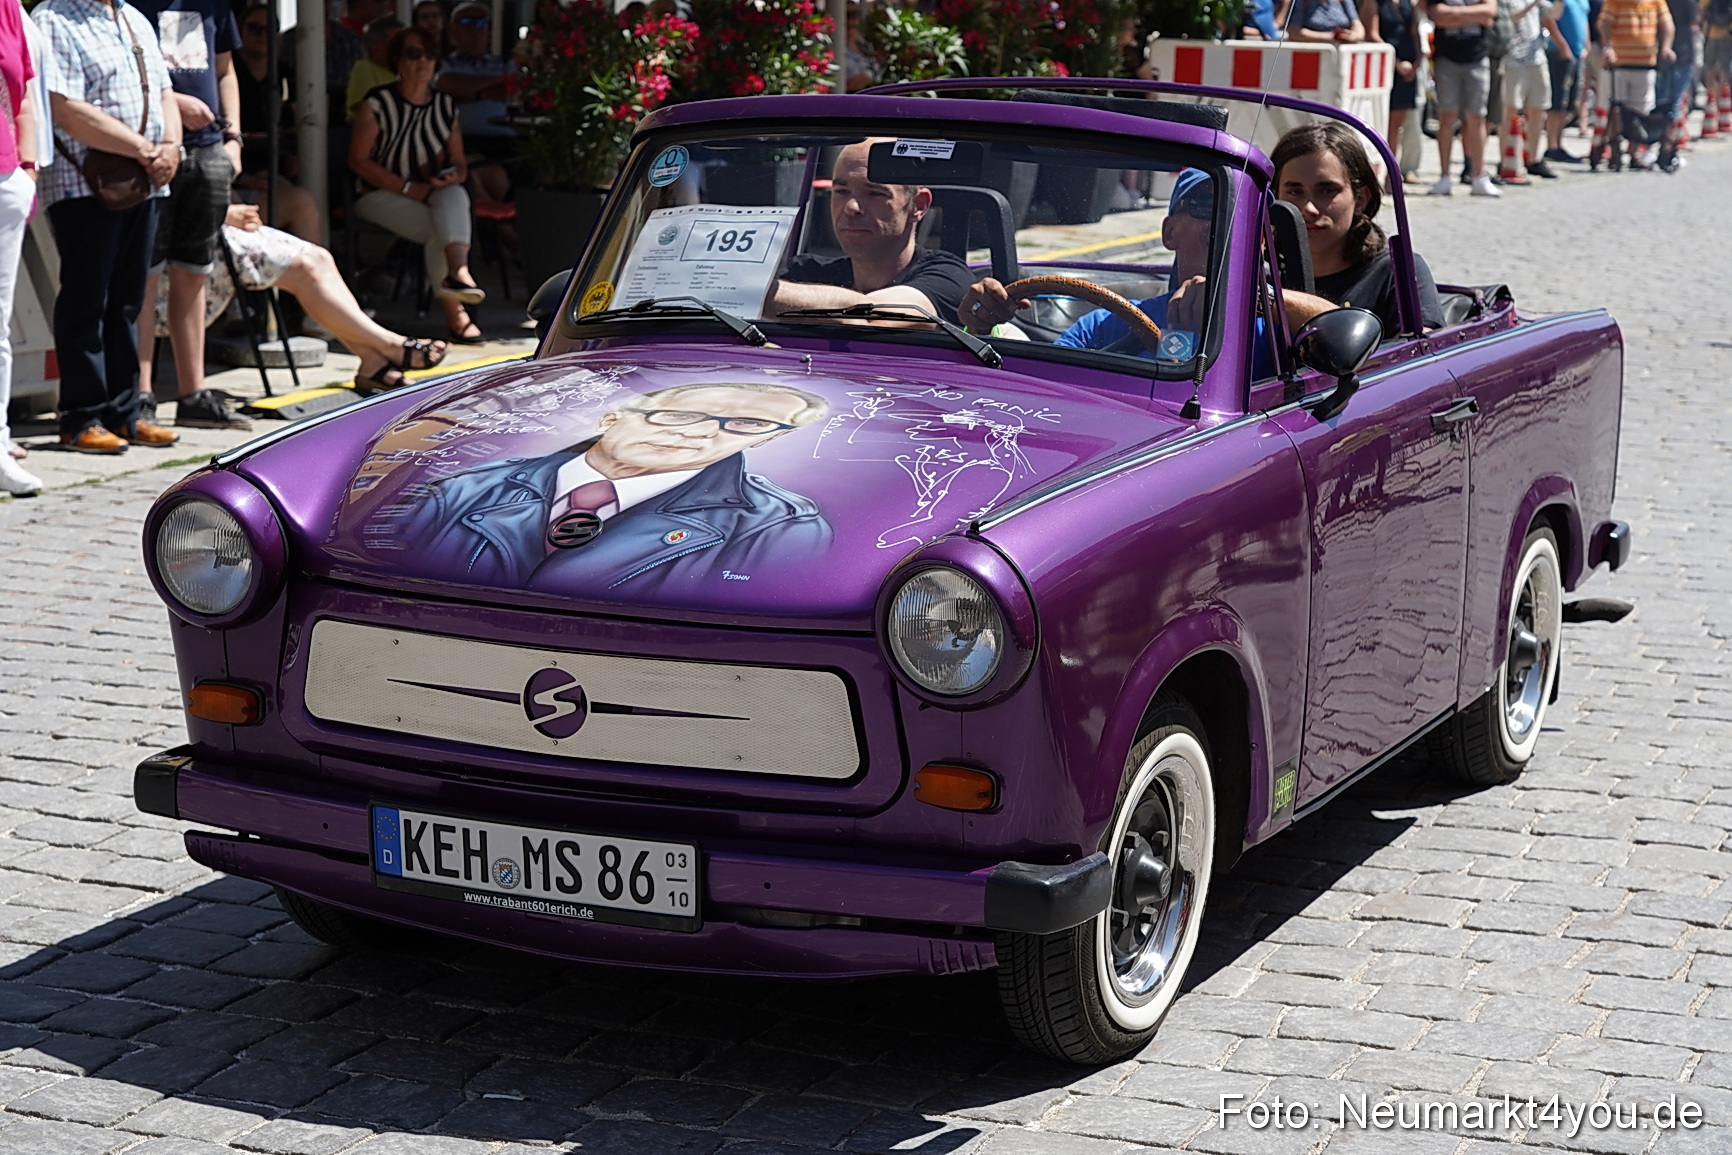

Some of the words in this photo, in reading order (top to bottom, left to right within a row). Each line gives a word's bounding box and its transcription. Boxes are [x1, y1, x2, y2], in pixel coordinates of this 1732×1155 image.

[706, 229, 757, 253] 195
[383, 849, 393, 865] D
[403, 818, 490, 884] KEH
[522, 835, 583, 895] MS
[598, 845, 655, 905] 86
[665, 852, 687, 869] 03
[463, 892, 595, 919] www.trabant601erich.de
[668, 891, 689, 908] 10
